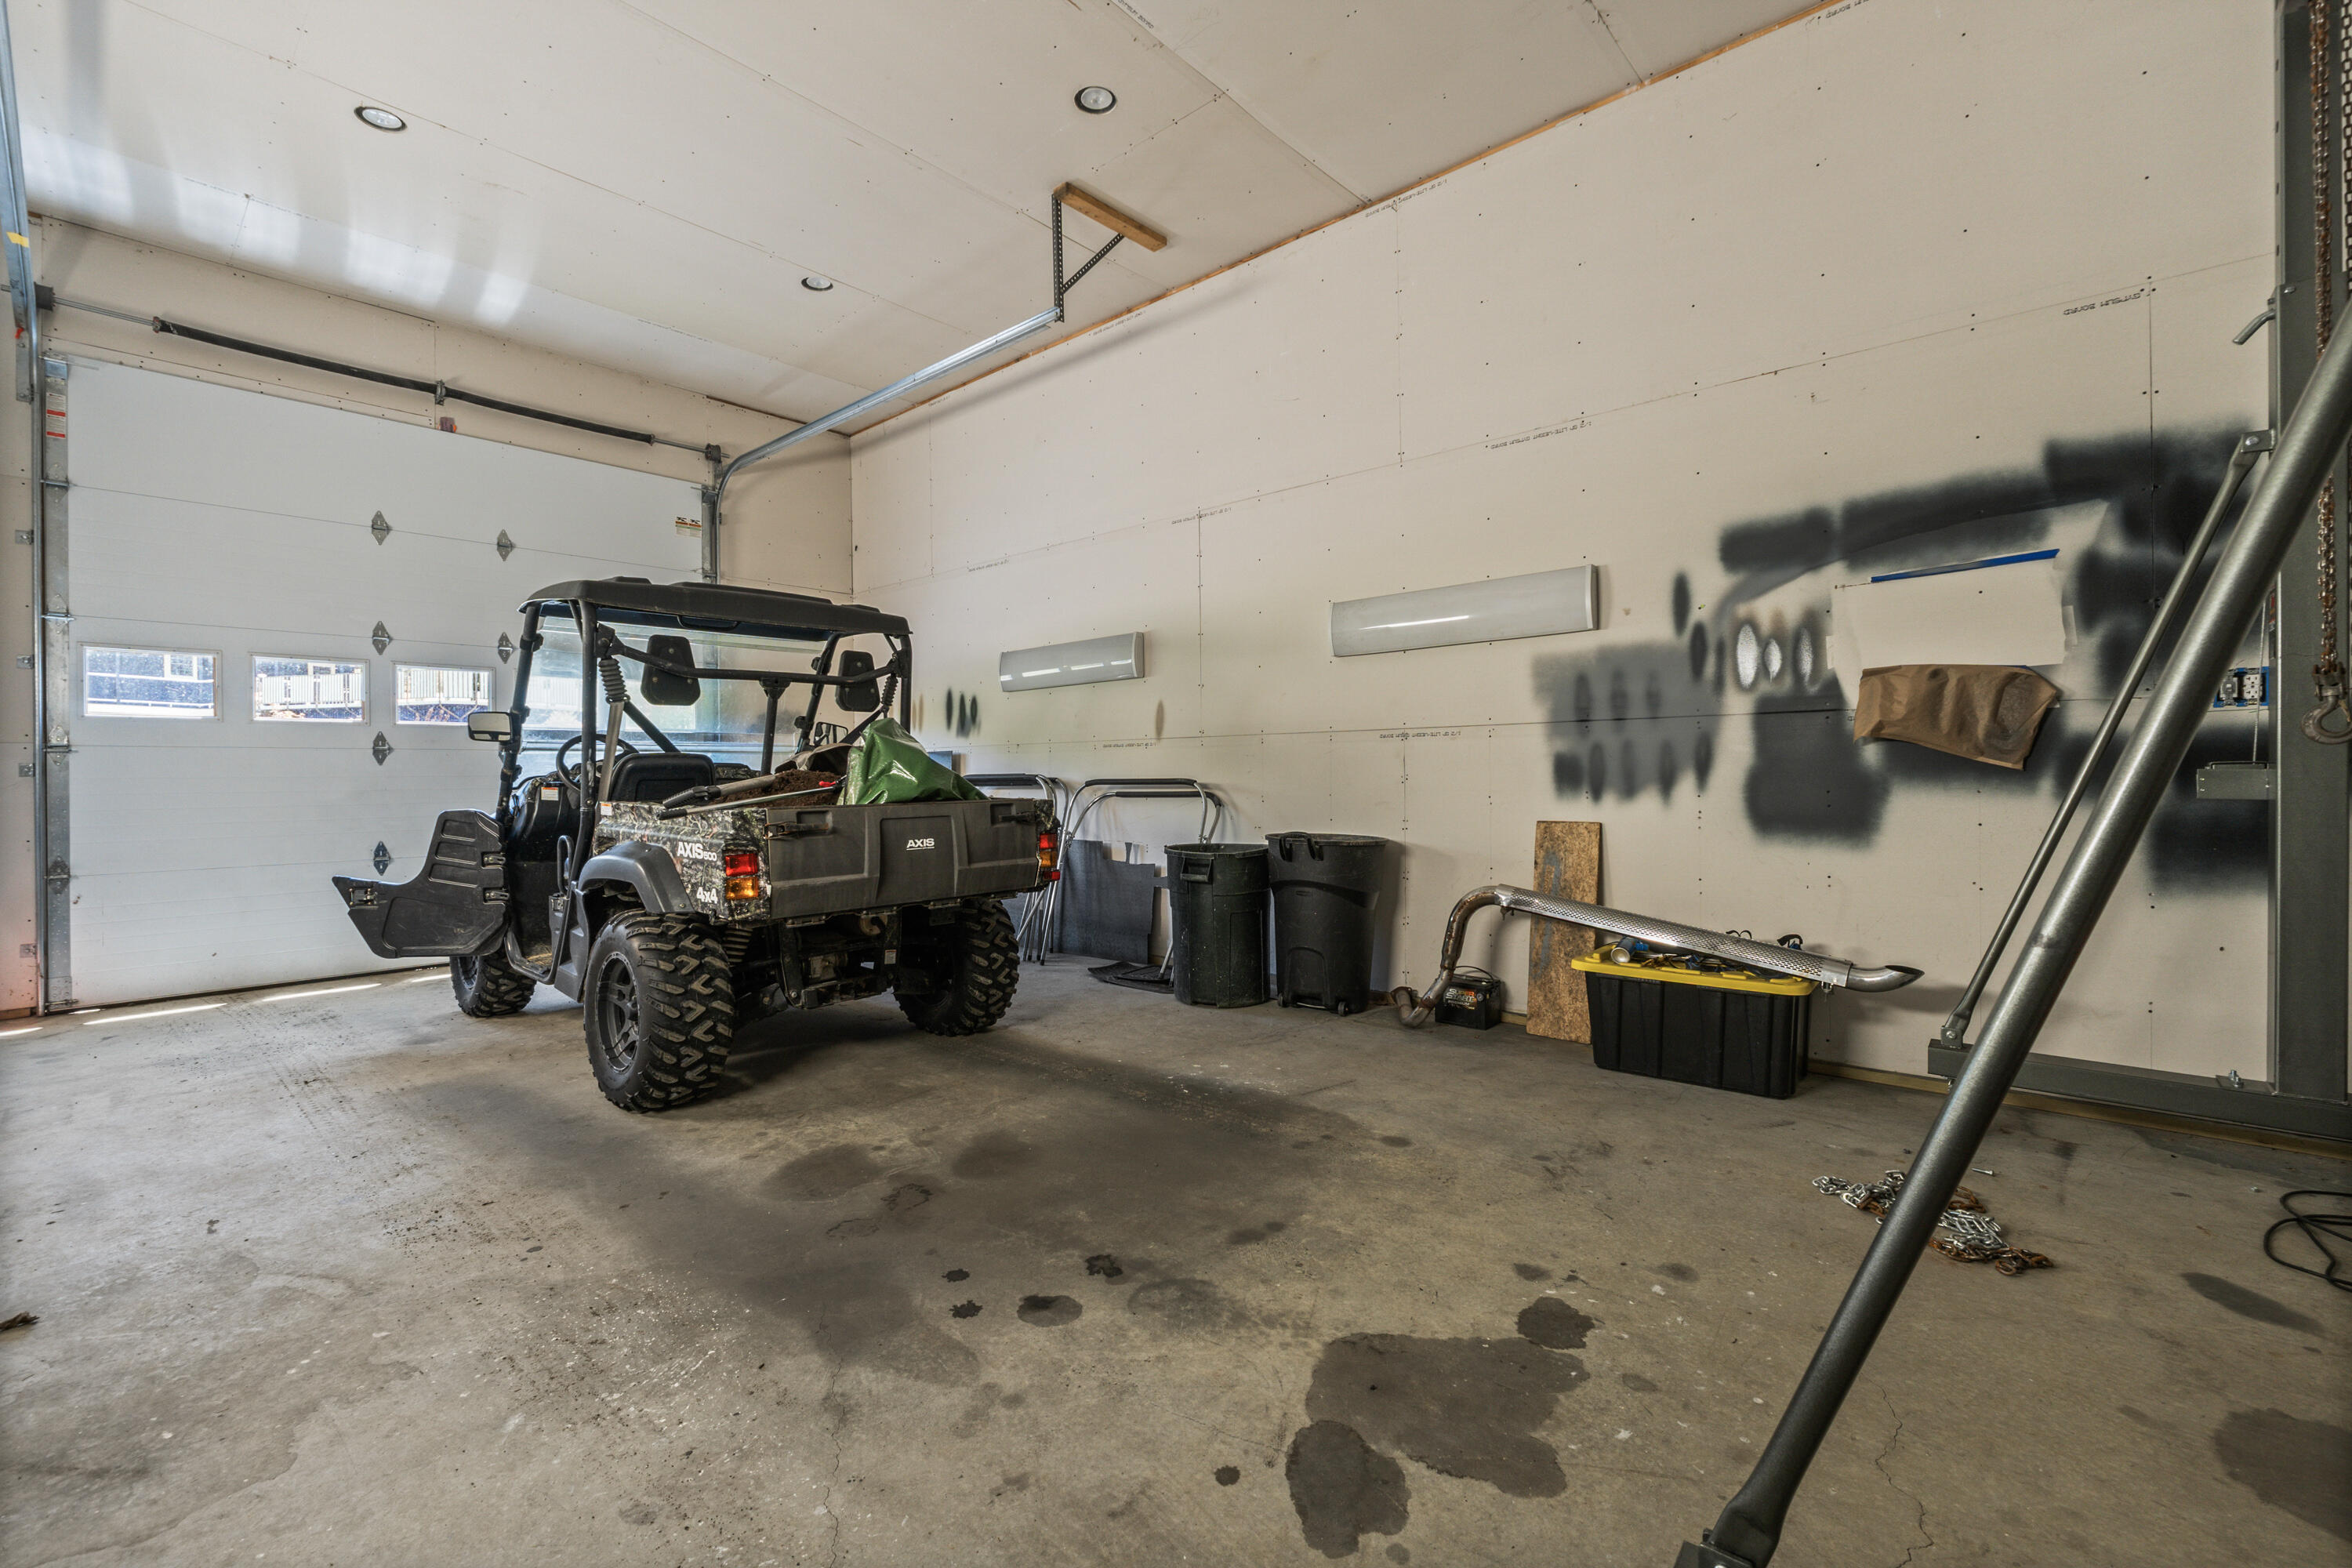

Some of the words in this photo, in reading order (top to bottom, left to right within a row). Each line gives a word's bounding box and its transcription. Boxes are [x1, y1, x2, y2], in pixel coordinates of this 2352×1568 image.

[2063, 303, 2096, 315] BOARD
[906, 837, 935, 848] AXIS
[677, 841, 704, 859] AXIS
[703, 851, 717, 862] 500
[696, 886, 718, 904] 4x4
